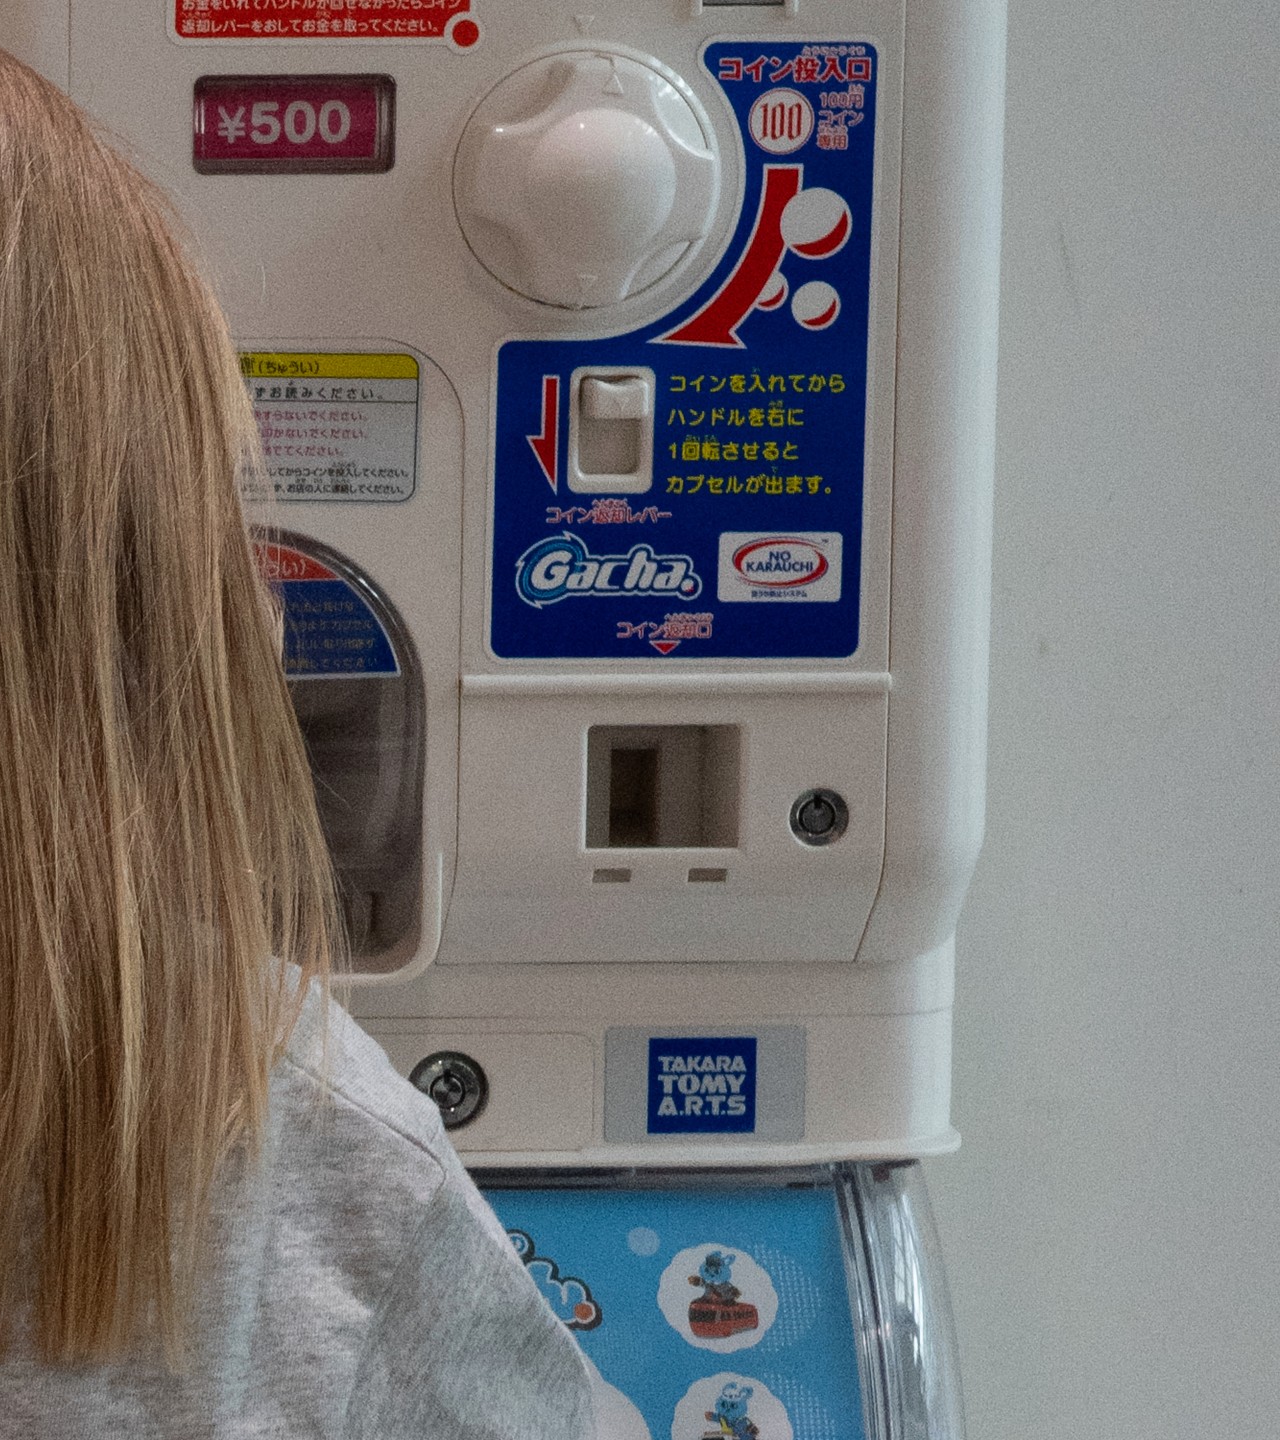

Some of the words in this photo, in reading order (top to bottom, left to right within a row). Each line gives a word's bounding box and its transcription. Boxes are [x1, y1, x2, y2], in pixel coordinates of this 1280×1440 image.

[719, 57, 872, 82] コイン投入口
[819, 92, 865, 108] 100円
[217, 100, 351, 145] ¥500
[759, 103, 803, 141] 100
[818, 111, 864, 127] コイン
[669, 374, 846, 393] コインを入れてから
[667, 407, 804, 427] ハンドルを右に
[668, 441, 800, 461] 1回転させると
[666, 475, 833, 495] カプセルが出ます。
[768, 550, 791, 561] NO
[746, 561, 814, 573] KARAUCHI
[657, 1055, 747, 1074] TAKARA
[658, 1075, 746, 1094] TOMY
